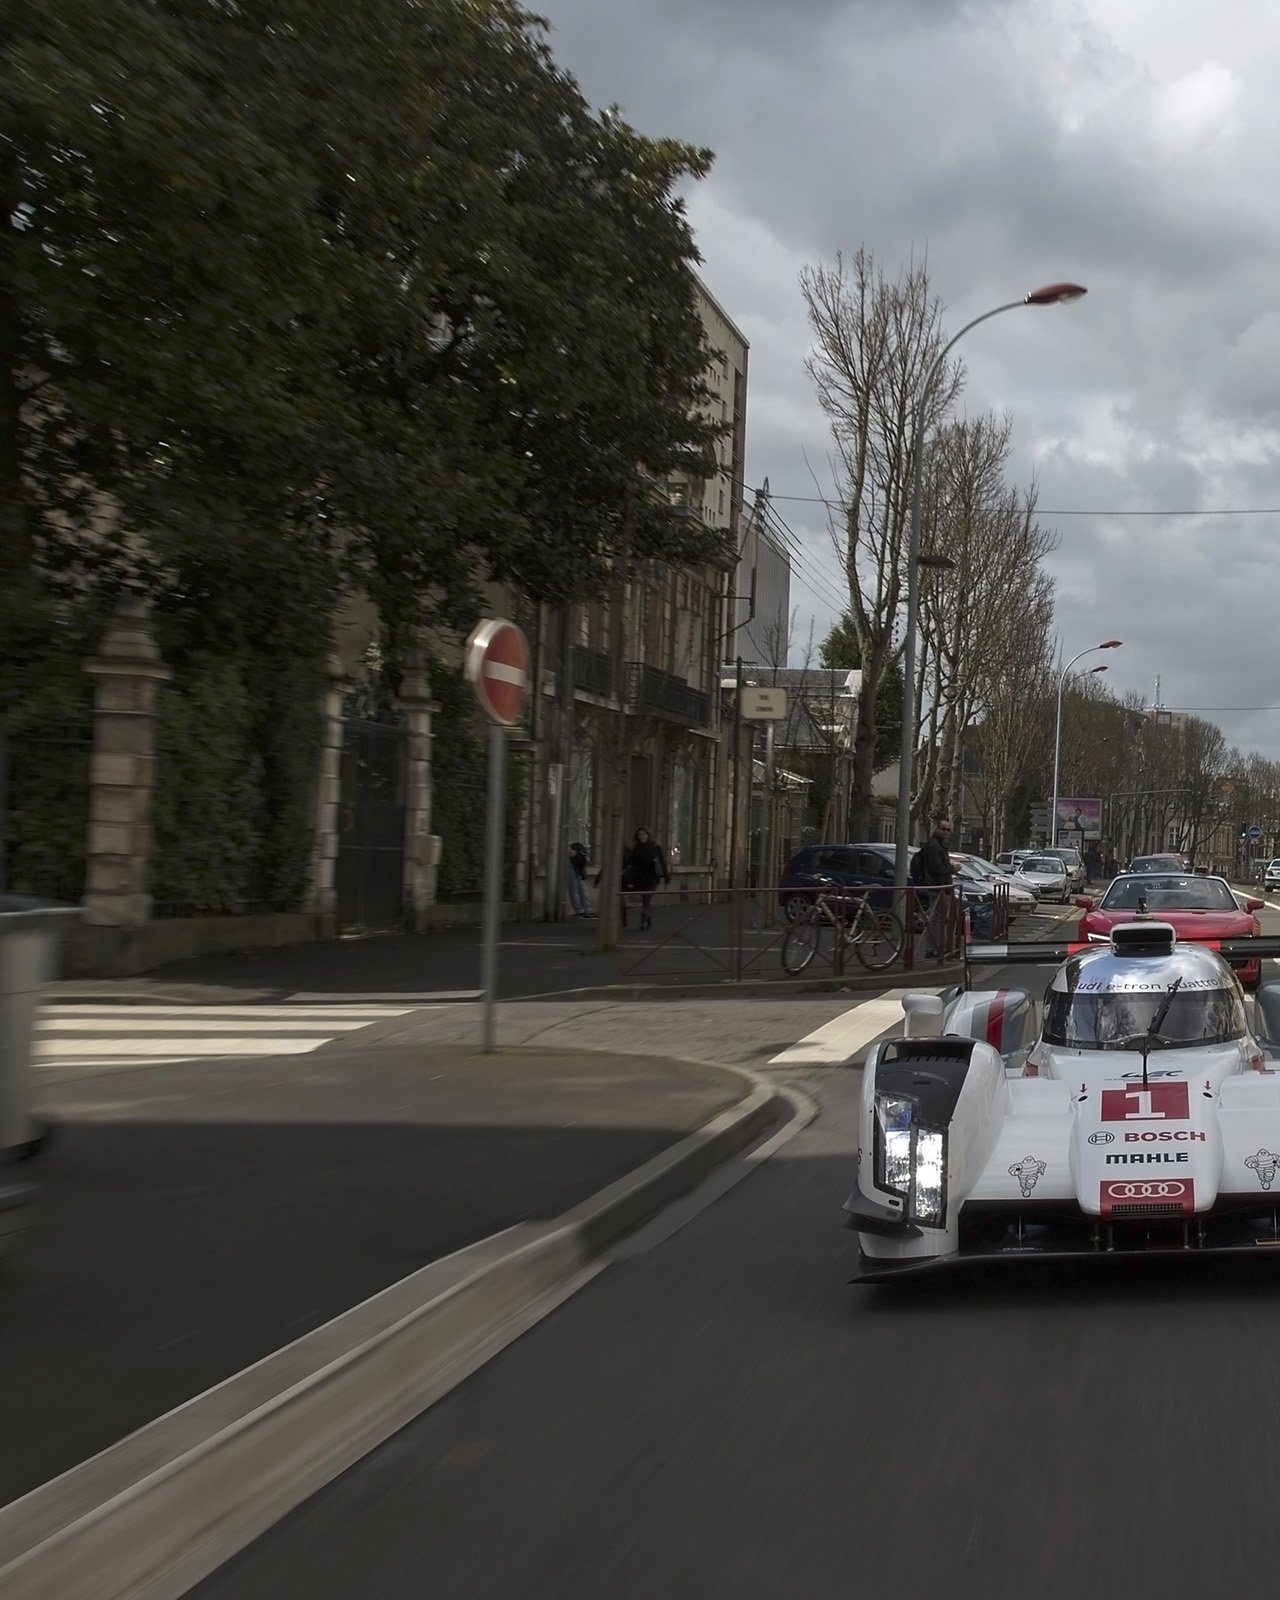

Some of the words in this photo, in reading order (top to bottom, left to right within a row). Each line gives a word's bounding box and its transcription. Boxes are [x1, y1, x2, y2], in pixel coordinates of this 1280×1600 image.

[1106, 982, 1161, 990] e-tron
[1125, 1091, 1166, 1119] 1
[1124, 1131, 1206, 1142] BOSCH
[1105, 1152, 1189, 1164] MAHLE
